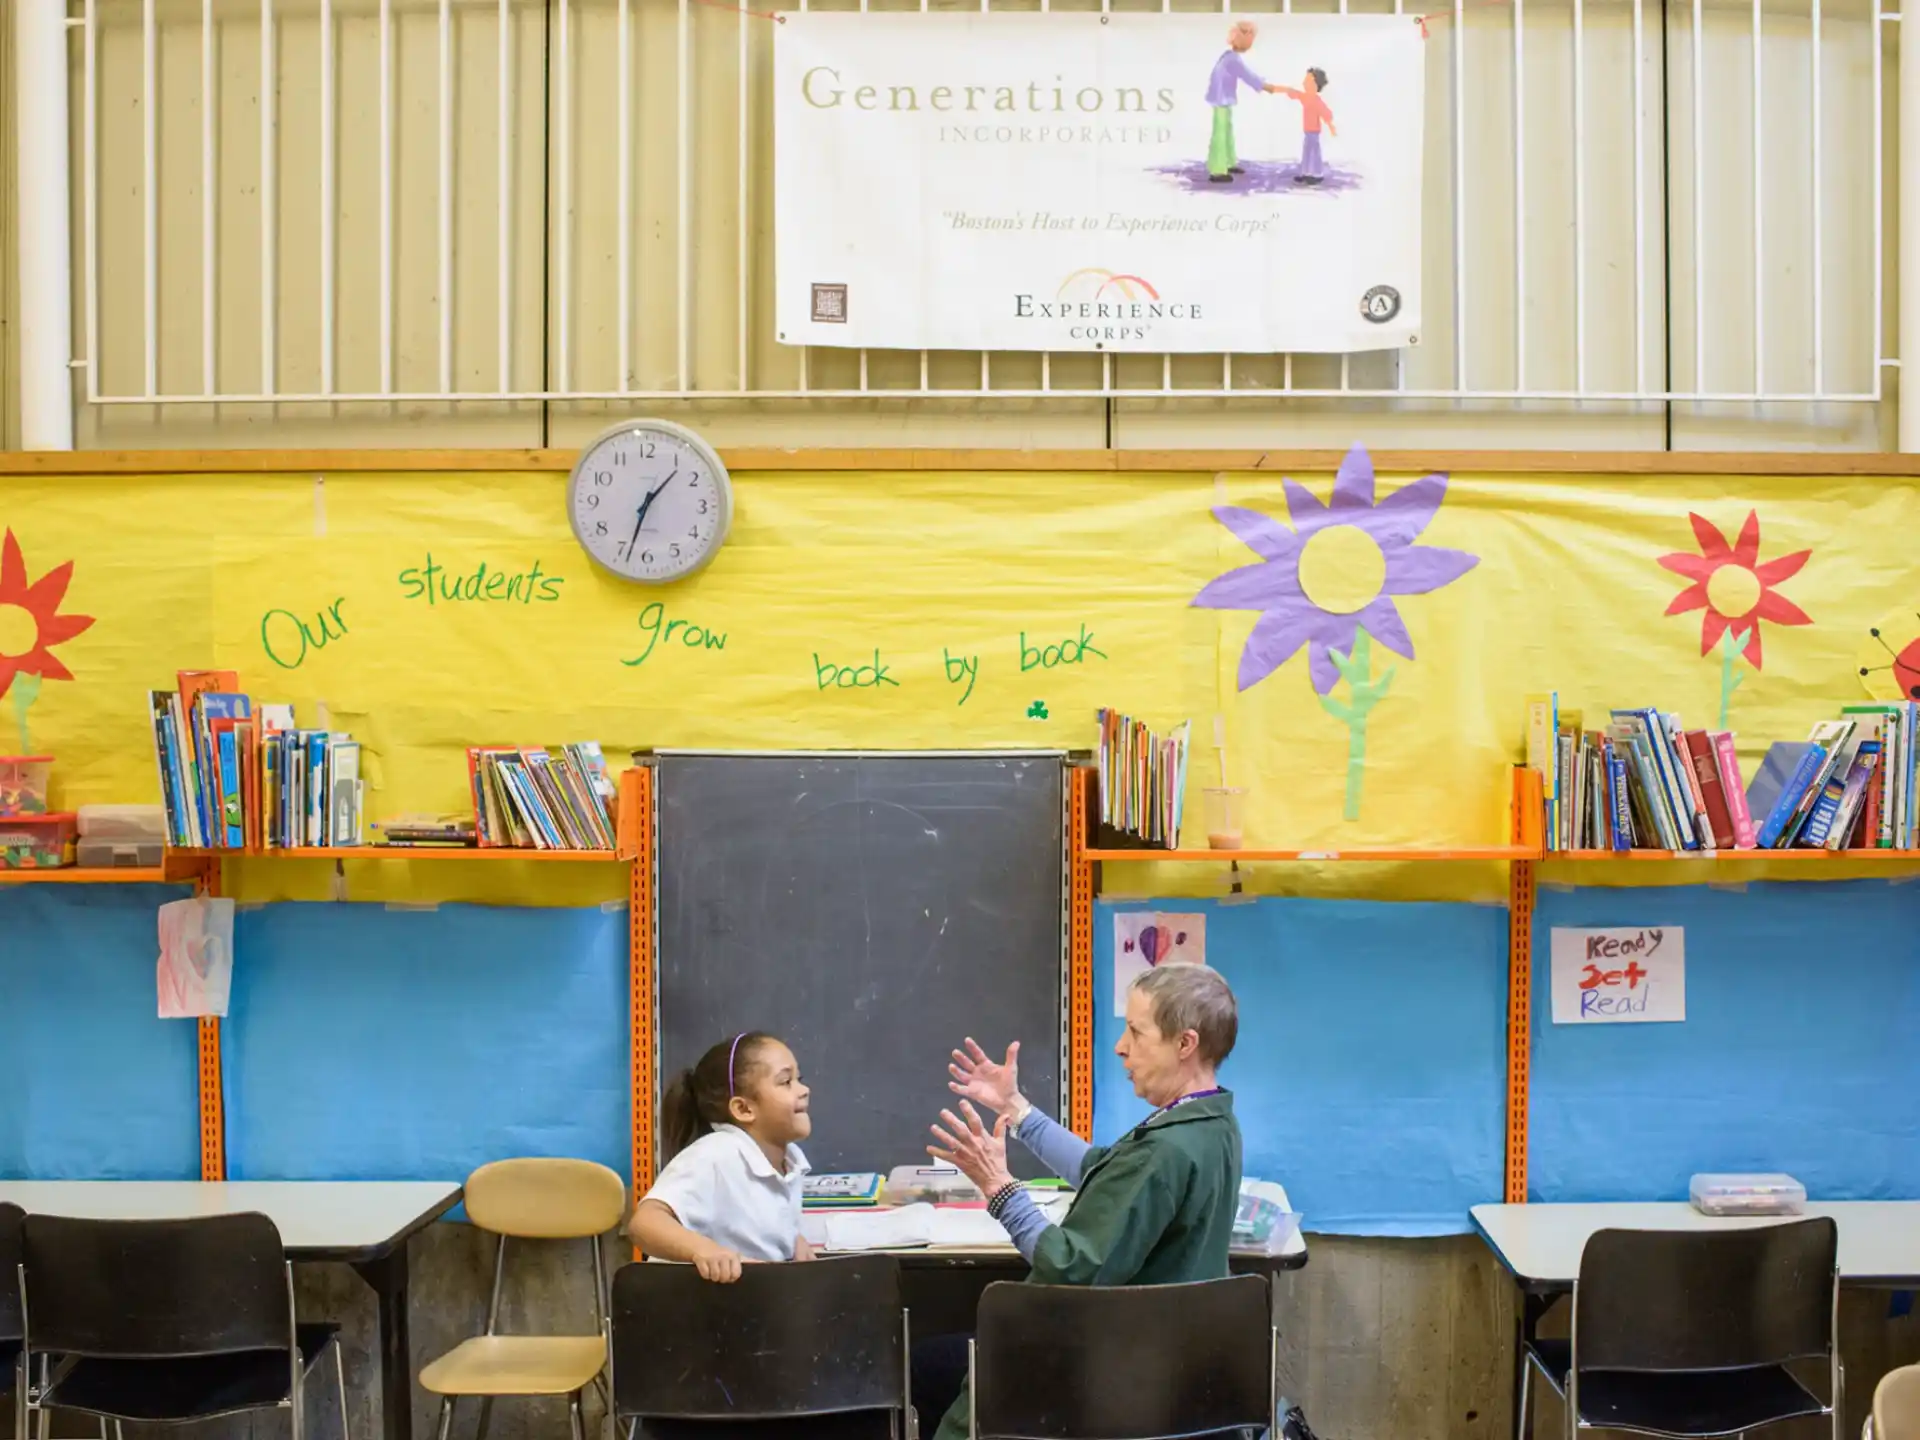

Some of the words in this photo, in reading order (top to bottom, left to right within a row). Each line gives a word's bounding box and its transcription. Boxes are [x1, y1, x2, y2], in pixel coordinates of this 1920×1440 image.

[802, 66, 1175, 112] Generations
[939, 126, 1172, 144] INCORPORATED
[1031, 212, 1076, 231] Host
[1081, 213, 1099, 231] to
[1105, 212, 1208, 236] Experience
[1014, 294, 1203, 320] EXPERIENCE
[615, 451, 626, 466] 11
[640, 443, 655, 459] 12
[594, 471, 613, 487] 10
[688, 471, 699, 487] 2
[587, 494, 600, 510] 9
[696, 499, 708, 515] 3
[595, 521, 609, 536] 8
[688, 525, 699, 540] 4
[617, 541, 627, 556] 7
[641, 548, 654, 564] 6
[669, 543, 681, 558] 5
[261, 597, 347, 670] Our
[399, 552, 565, 604] students
[620, 602, 727, 666] grow
[813, 648, 900, 690] book
[944, 647, 978, 706] by
[1020, 623, 1108, 672] book
[1581, 983, 1650, 1018] Read
